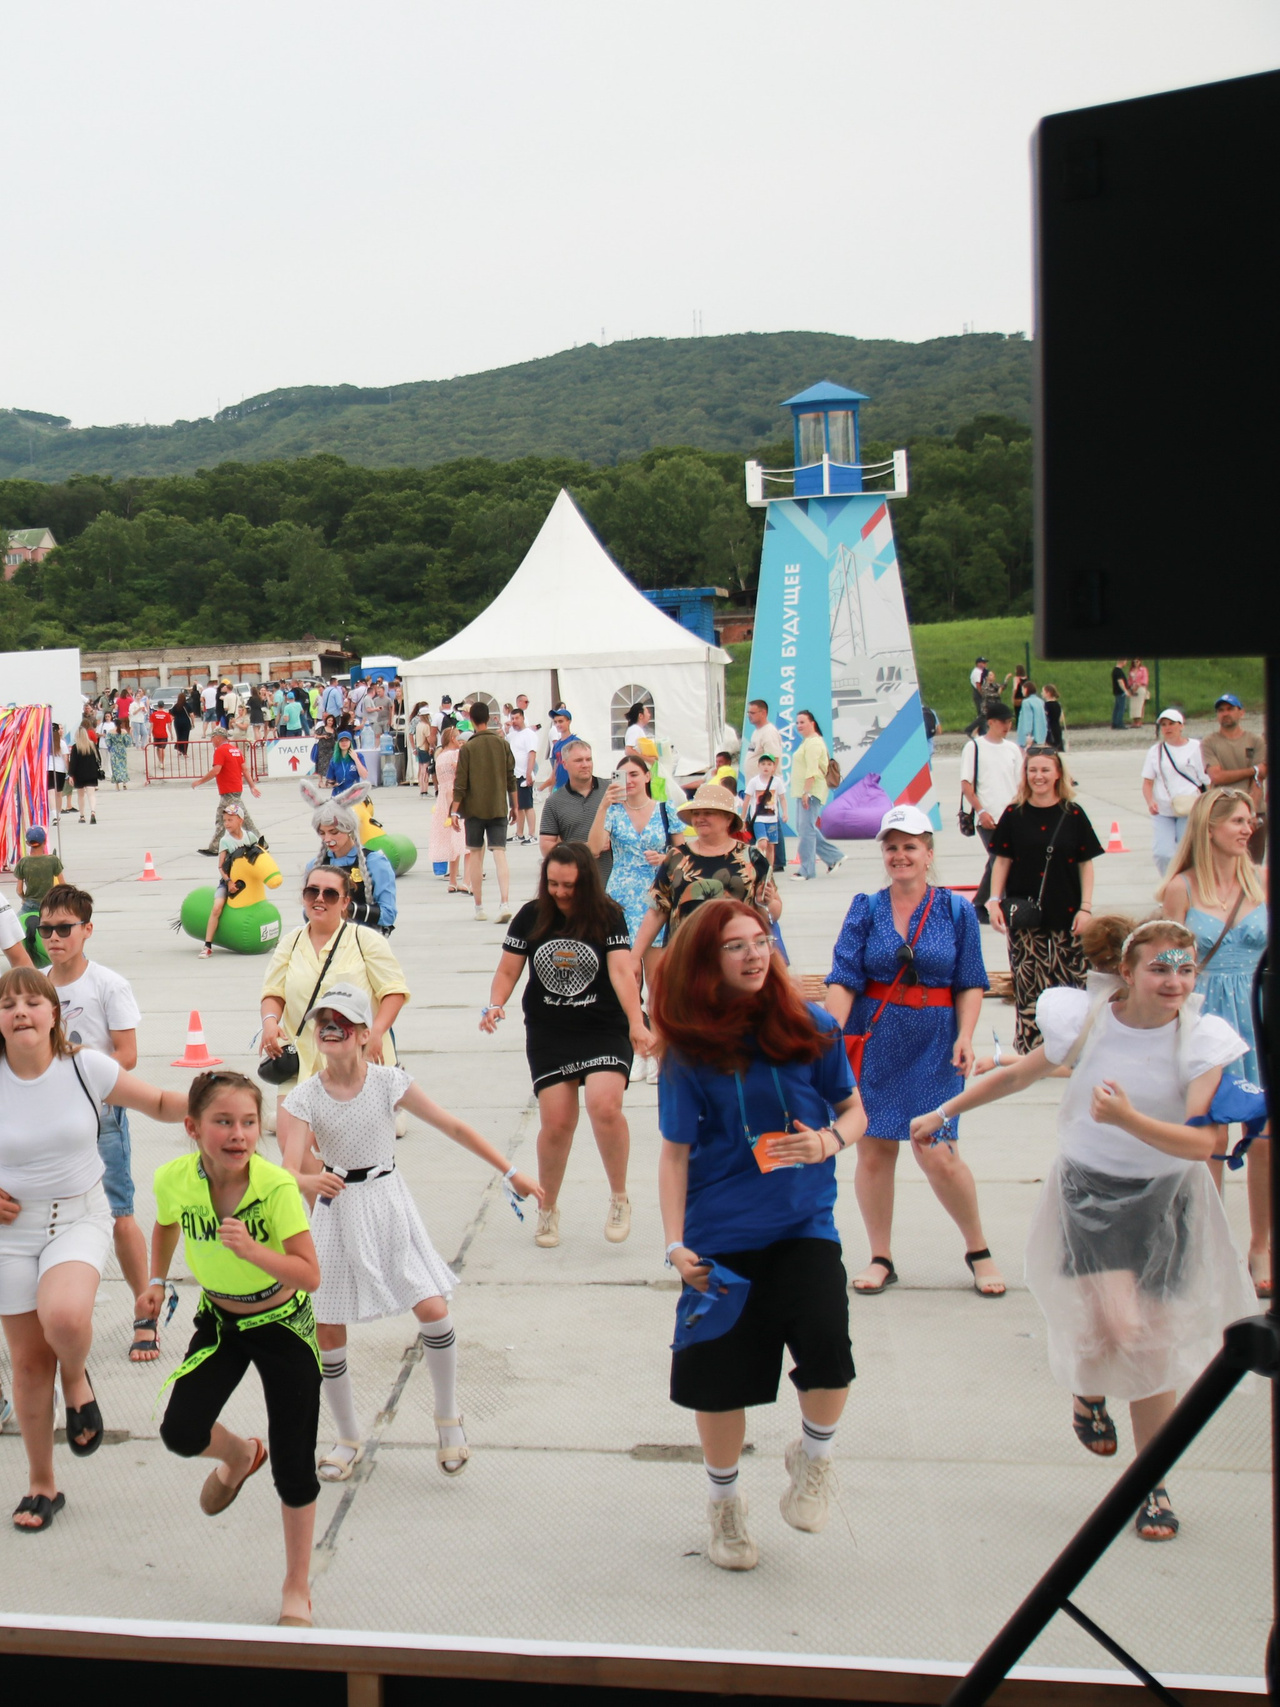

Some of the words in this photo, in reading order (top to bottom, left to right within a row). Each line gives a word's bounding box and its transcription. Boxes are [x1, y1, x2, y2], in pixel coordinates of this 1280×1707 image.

[781, 563, 802, 658] БУДУЩЕЕ
[778, 665, 796, 790] СОЗДАВАЯ
[278, 745, 309, 755] ТУАЛЕТ
[180, 1205, 210, 1217] YOU
[181, 1211, 270, 1243] ALWYS
